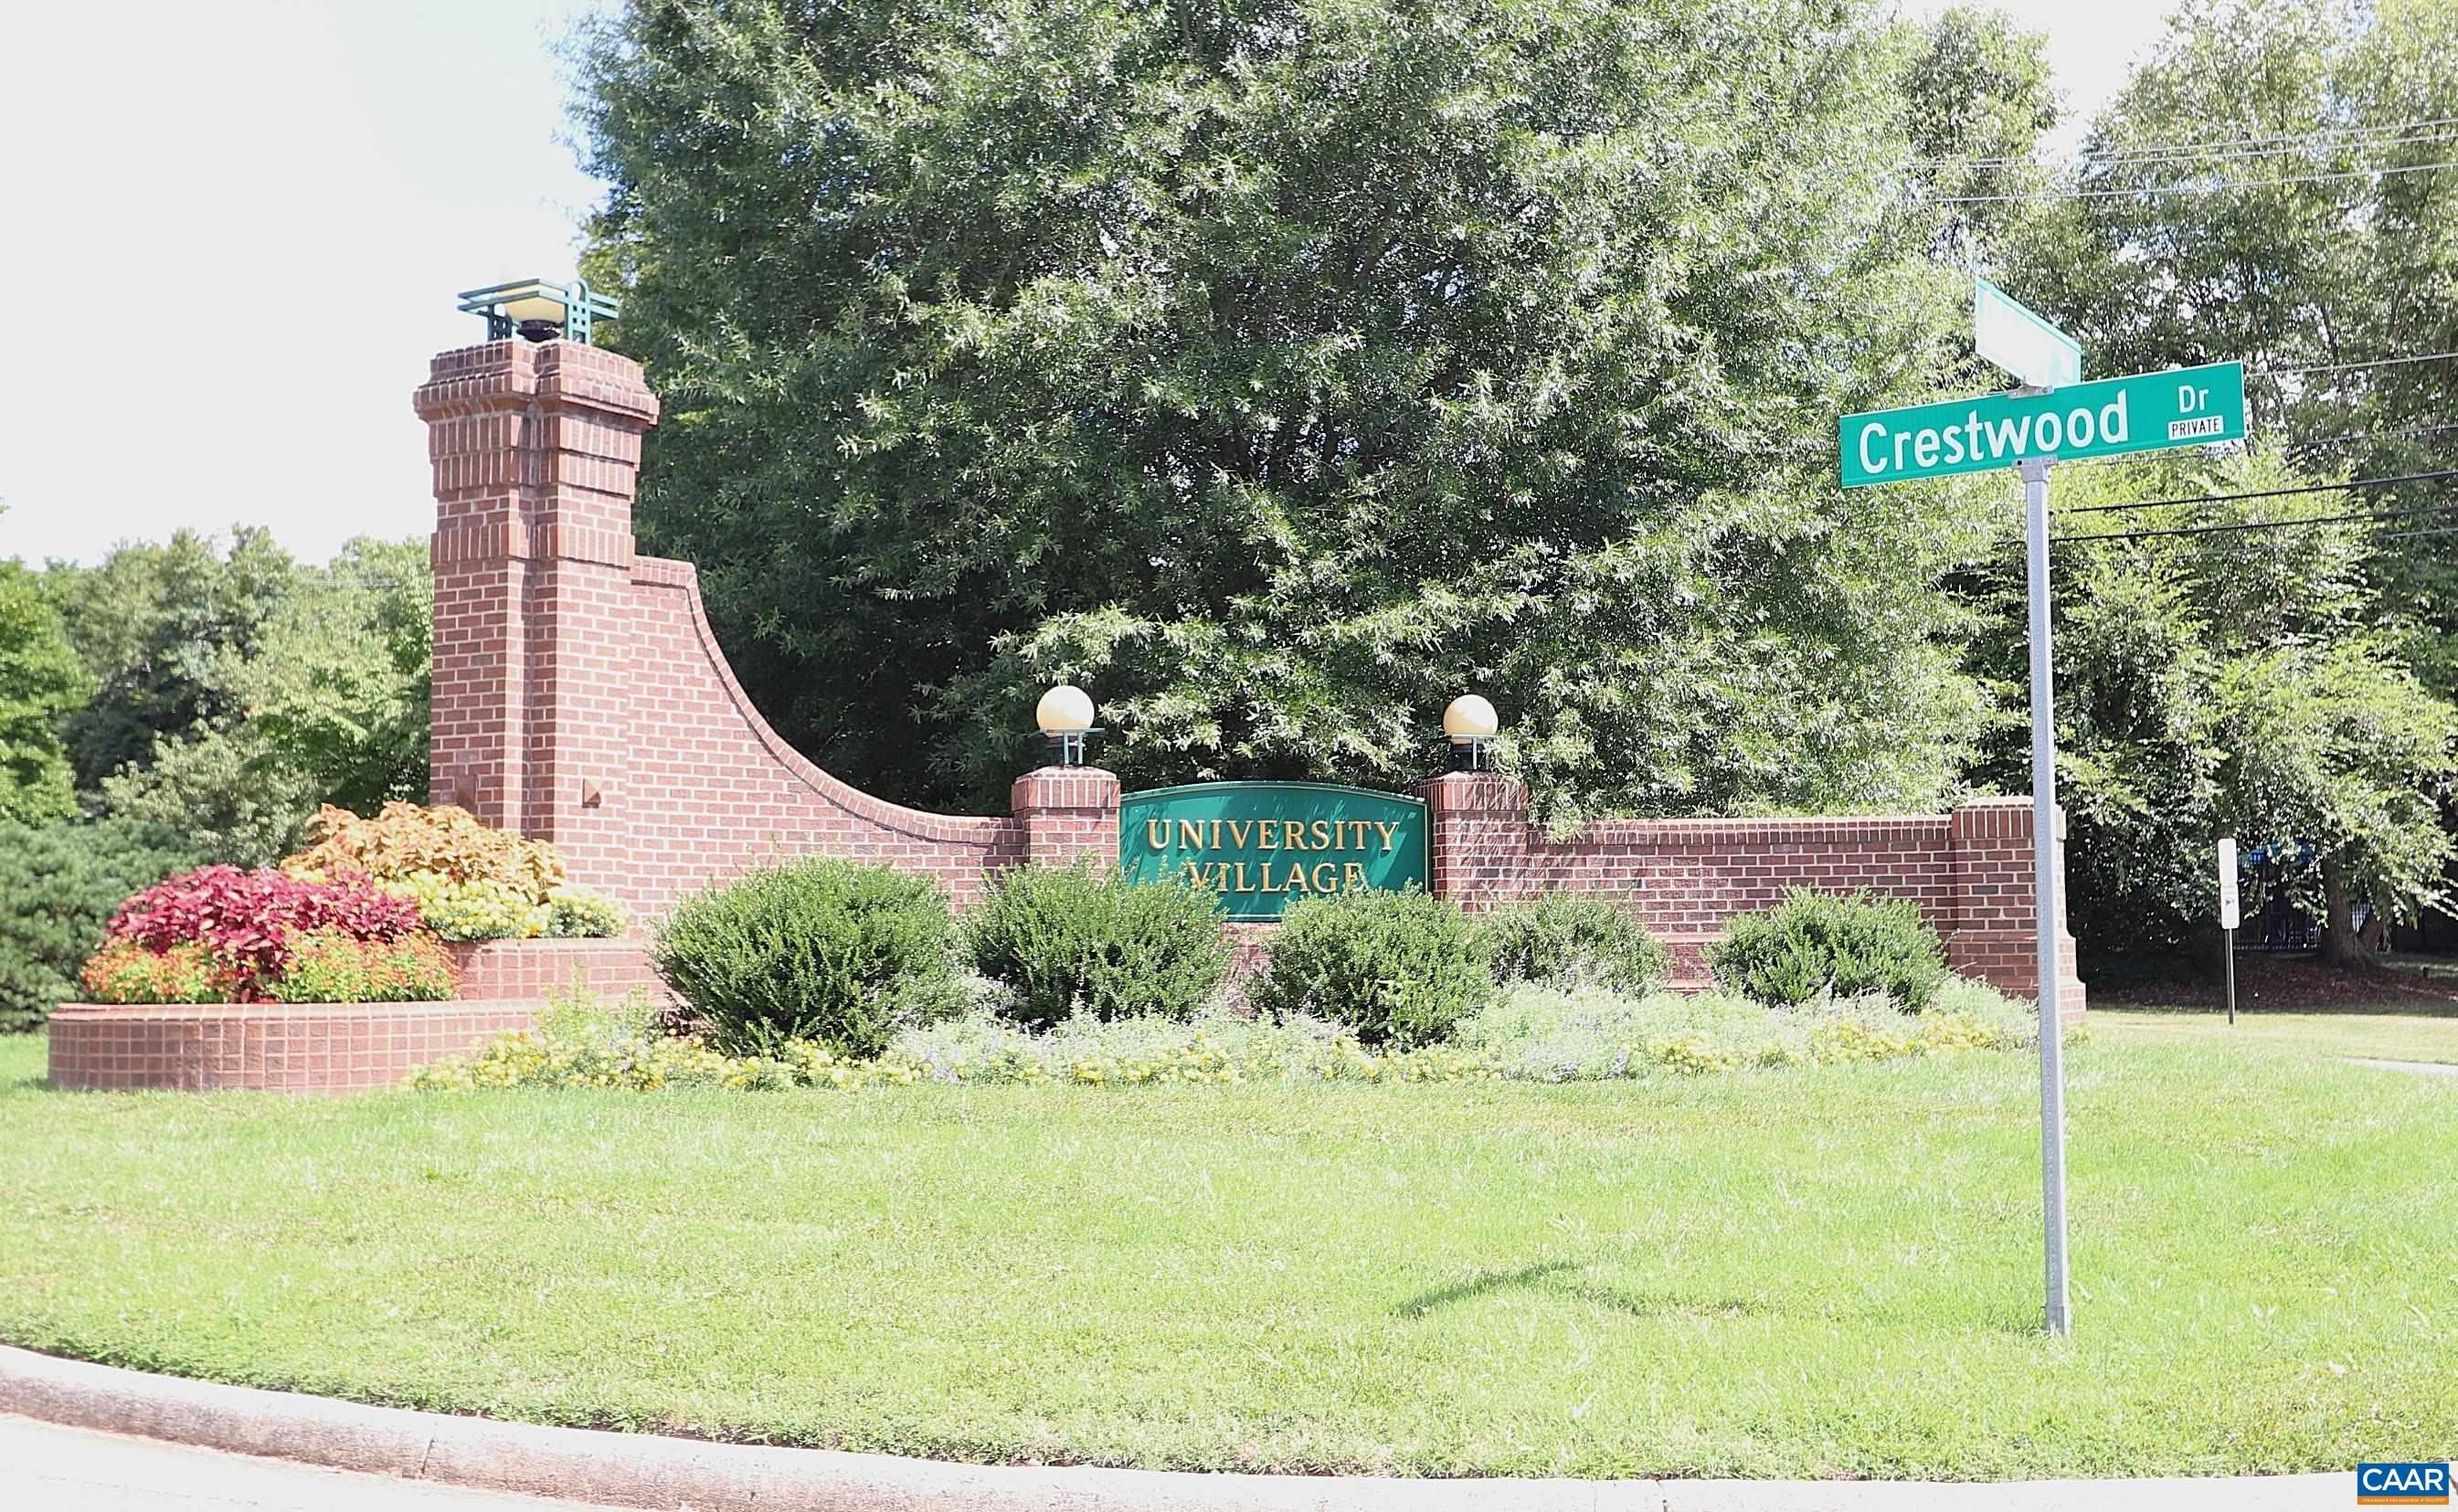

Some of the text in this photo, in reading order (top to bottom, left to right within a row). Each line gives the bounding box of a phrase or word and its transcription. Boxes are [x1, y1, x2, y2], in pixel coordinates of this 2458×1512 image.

[1859, 385, 2209, 474] Crestwood Dr
[2171, 418, 2220, 438] PRIVATE
[1147, 819, 1399, 851] UNIVERSITY
[1187, 862, 1369, 893] VILLAGE
